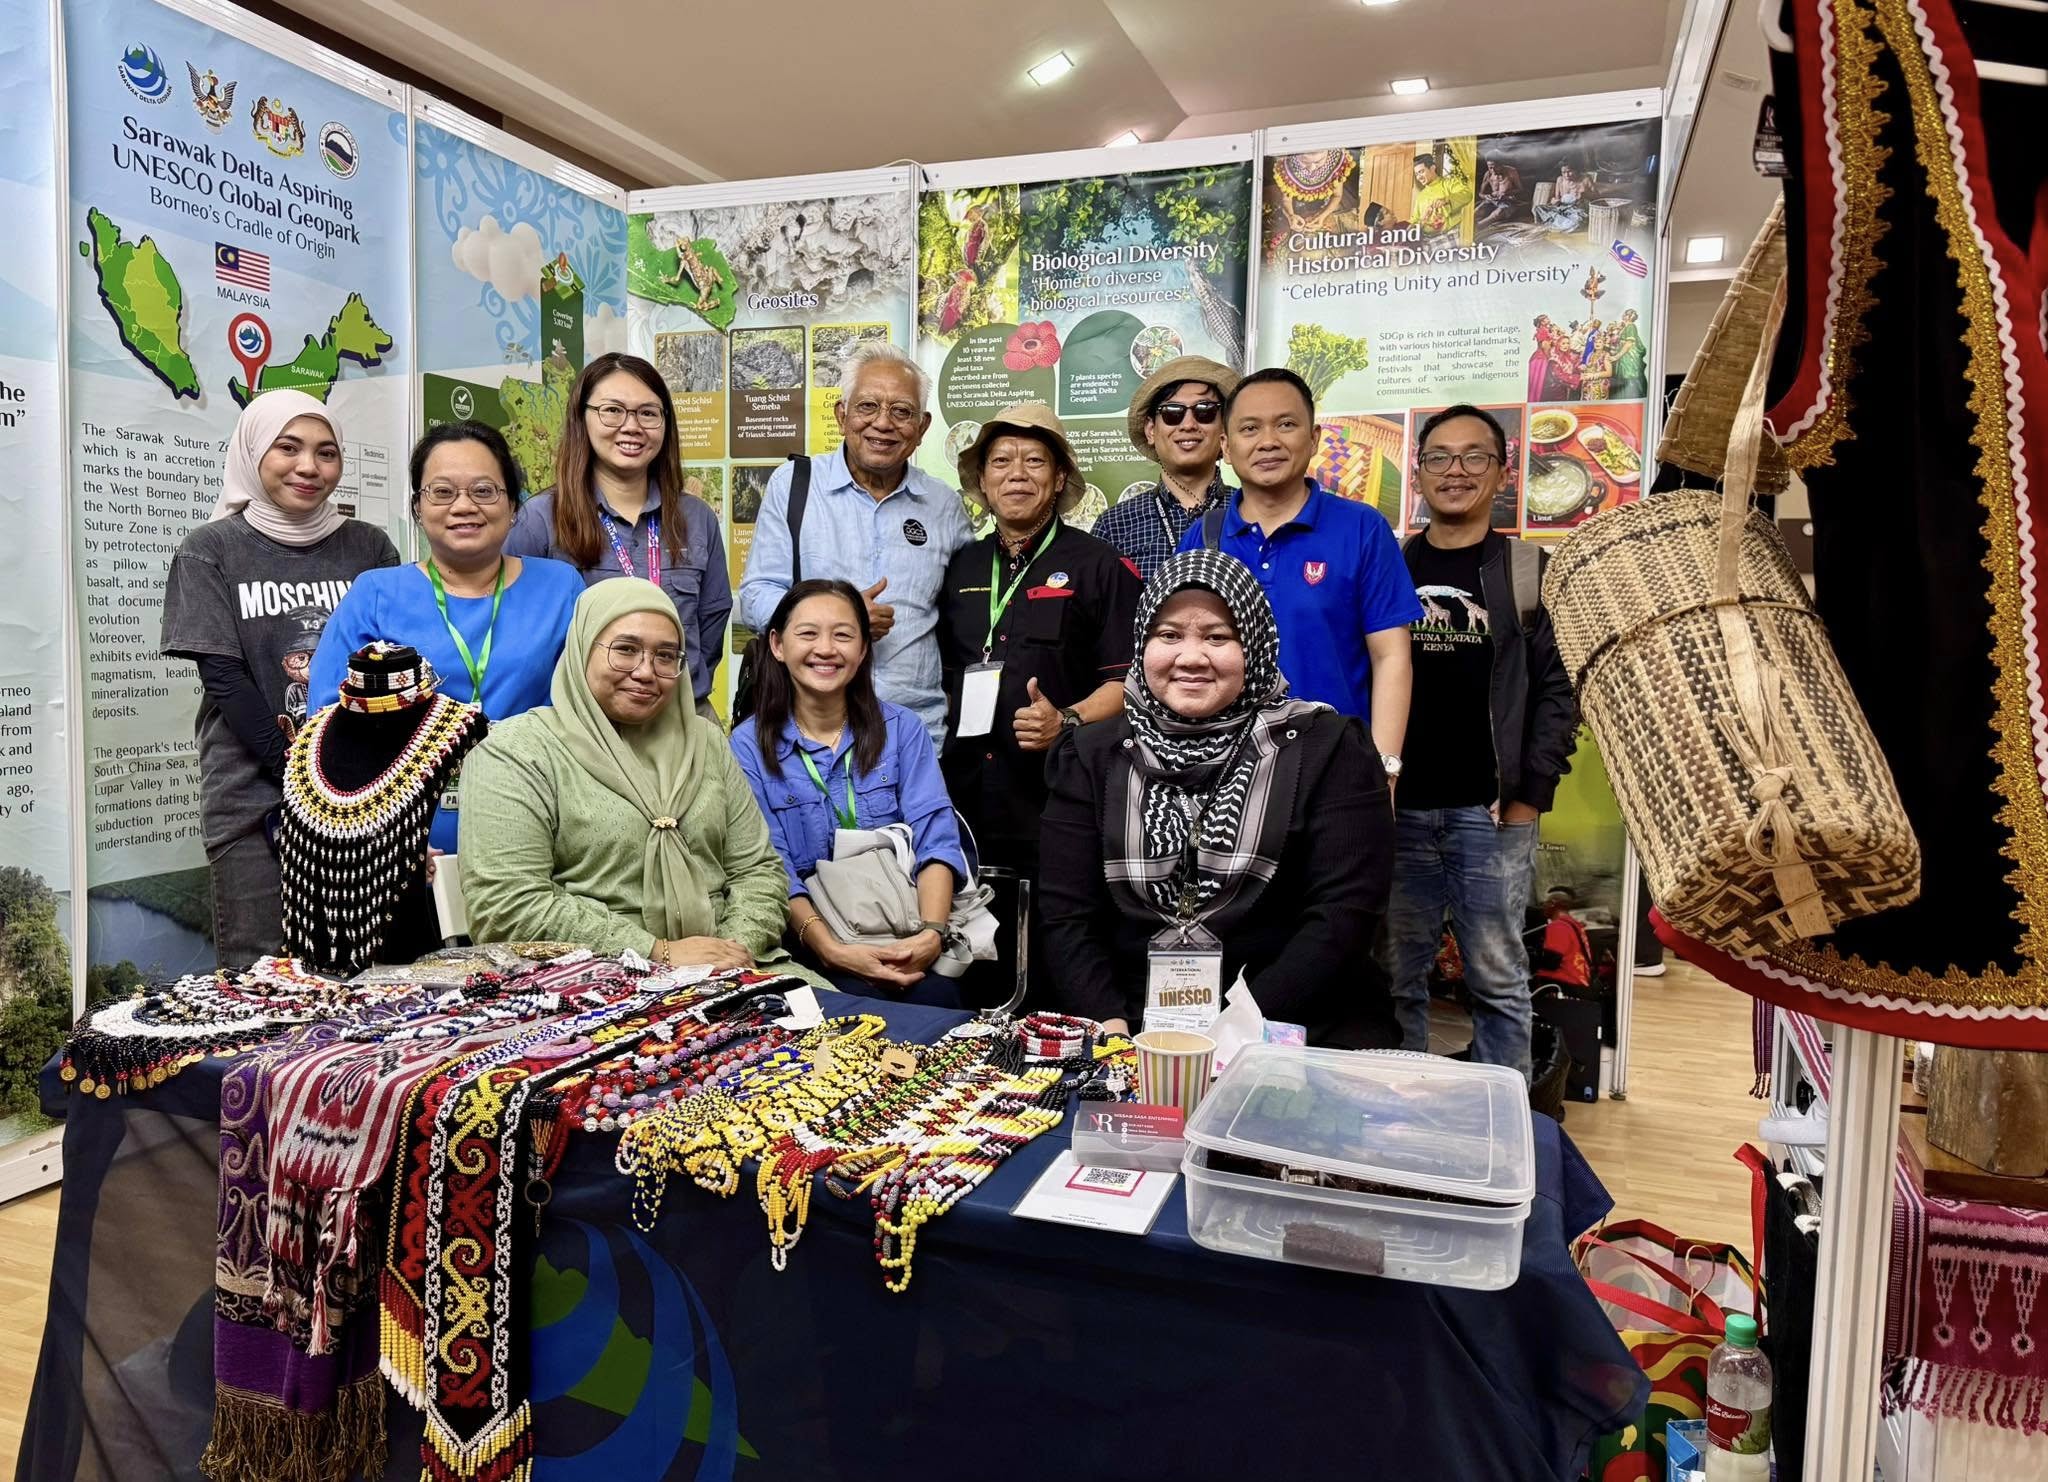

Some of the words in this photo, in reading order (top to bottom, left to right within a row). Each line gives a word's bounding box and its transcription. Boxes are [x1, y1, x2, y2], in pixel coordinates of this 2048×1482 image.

[118, 65, 138, 97] SARAWAK
[140, 94, 156, 104] DELTA
[123, 116, 216, 168] Sarawak
[222, 150, 273, 187] Delta
[279, 174, 352, 220] Aspiring
[112, 144, 213, 195] UNESCO
[219, 181, 281, 218] Global
[288, 204, 360, 245] Geopark
[225, 211, 272, 239] Cradle
[278, 229, 292, 244] of
[296, 234, 334, 259] Origin
[1289, 228, 1373, 251] Cultural
[1381, 224, 1420, 243] and
[1032, 248, 1121, 271] Biological
[1130, 242, 1219, 262] Diversity
[1288, 249, 1390, 275] Historical
[1399, 243, 1498, 266] Diversity
[1086, 274, 1100, 286] to
[1106, 271, 1161, 286] diverse
[1282, 278, 1388, 299] “Celebrating
[1394, 274, 1441, 292] Unity
[1448, 271, 1480, 288] and
[1487, 264, 1580, 284] Diversity”
[218, 287, 270, 309] MALAYSIA
[748, 291, 819, 310] Geosites
[1031, 292, 1100, 312] biological
[989, 337, 1002, 345] past
[1379, 332, 1404, 341] SDGp
[1417, 331, 1433, 339] rich
[1448, 327, 1480, 336] cultural
[1379, 343, 1397, 351] with
[1432, 339, 1471, 349] historical
[1474, 337, 1520, 345] landmarks,
[1379, 354, 1421, 362] traditional
[1437, 350, 1487, 360] handicrafts,
[1504, 347, 1519, 355] and
[291, 366, 324, 378] SARAWAK
[1378, 365, 1412, 374] festivals
[1452, 361, 1493, 369] showcase
[1434, 374, 1465, 382] various
[1472, 371, 1519, 380] indigenous
[1377, 386, 1432, 395] communities.
[744, 394, 766, 403] Tuang
[82, 423, 105, 437] The
[116, 428, 164, 444] Sarawak
[174, 436, 209, 450] Suture
[83, 443, 118, 457] which
[127, 448, 136, 459] is
[144, 452, 157, 462] an
[166, 454, 215, 468] accretion
[84, 464, 119, 476] marks
[125, 466, 142, 479] the
[148, 469, 200, 487] boundary
[84, 481, 102, 493] the
[110, 483, 138, 496] West
[147, 486, 186, 501] Borneo
[84, 500, 103, 512] the
[108, 502, 141, 515] North
[148, 505, 186, 519] Borneo
[85, 519, 123, 532] Suture
[129, 522, 157, 535] Zone
[163, 525, 171, 536] is
[85, 538, 99, 550] by
[86, 559, 98, 568] as
[114, 558, 148, 571] pillow
[87, 576, 123, 589] basalt,
[128, 577, 148, 589] and
[88, 595, 108, 606] that
[89, 613, 140, 625] evolution
[301, 620, 319, 629] Y-3
[89, 632, 145, 644] Moreover,
[1445, 634, 1482, 644] MATATA
[1423, 643, 1455, 651] KENYA
[91, 652, 132, 662] exhibits
[91, 669, 156, 683] magmatism,
[92, 687, 169, 700] mineralization
[93, 706, 139, 720] deposits.
[1, 724, 31, 736] from
[9, 743, 32, 756] and
[94, 747, 112, 759] The
[116, 741, 169, 759] geopark's
[95, 764, 123, 777] South
[129, 761, 161, 773] China
[166, 759, 187, 769] Sea,
[7, 784, 33, 797] ago,
[95, 784, 124, 797] Lupar
[130, 779, 163, 791] Valley
[170, 777, 179, 786] in
[21, 800, 34, 813] of
[95, 799, 152, 814] formations
[156, 793, 189, 806] dating
[95, 816, 153, 833] subduction
[96, 831, 171, 851] understanding
[175, 826, 186, 837] of
[1159, 988, 1212, 1007] UNESCO
